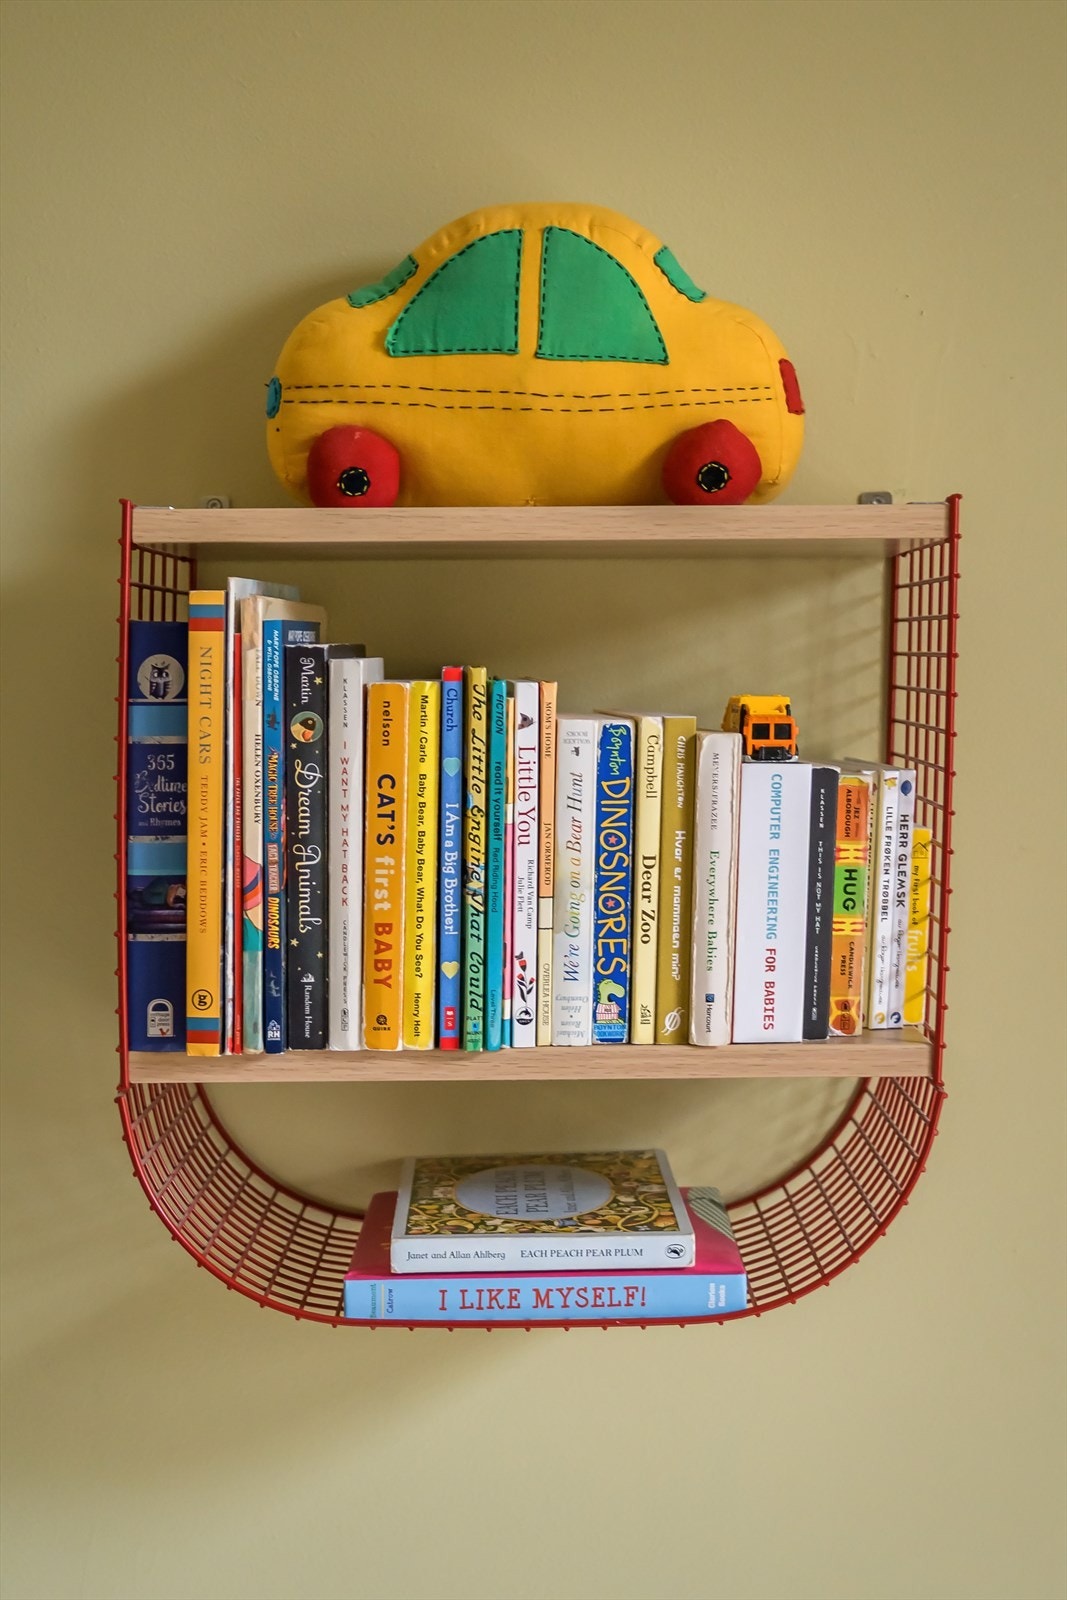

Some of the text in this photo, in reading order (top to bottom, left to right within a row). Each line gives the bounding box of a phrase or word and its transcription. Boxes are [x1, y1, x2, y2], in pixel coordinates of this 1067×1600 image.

[299, 657, 314, 705] Martin
[472, 684, 486, 721] The
[147, 754, 175, 771] 365
[340, 757, 349, 798] WANT
[471, 728, 486, 794] Little
[137, 792, 187, 815] Stories
[198, 646, 213, 934] NIGHT CARS TEDDY JAM ERIC BEDDOWS
[253, 770, 261, 825] OXENBURY
[267, 753, 280, 833] MAGIC TREE HOUSE
[294, 758, 323, 839] Dream
[340, 803, 349, 823] MY
[443, 688, 458, 935] Church I Am a Big Brother!
[516, 746, 537, 847] Little You
[844, 788, 854, 838] ALBOROUGH
[853, 806, 861, 820] JEZ
[340, 828, 349, 859] HAT
[373, 701, 396, 989] nelson CAT'S first BABY
[412, 695, 429, 1037] Martin Carle Baby Bear, Baby Bear, What Do You See? Henry Holt
[468, 805, 486, 882] Engine
[489, 693, 505, 1028] FICTION read it yourself Red Riding Hood Level Three
[541, 702, 552, 1026] MOM'S HOME JAN ORMEROD OVERLEA HOUSE
[596, 725, 630, 976] Boynton DINOSNORES
[640, 734, 659, 945] Campbell Dear Zoo
[670, 735, 686, 981] CHRIS HAUGHTON Hvar er mammaen min?
[880, 806, 894, 922] LILLE FRØKEN TRØBBEL
[896, 814, 910, 908] HERR GLEMSK
[267, 843, 279, 892] FACT TRACKER
[292, 844, 322, 934] Animals
[341, 864, 349, 907] BACK
[563, 773, 586, 982] We're Going on a Bear Hunt
[706, 850, 720, 926] Everywhere
[817, 867, 822, 880] IS
[842, 868, 858, 912] HUG
[467, 888, 485, 942] That
[516, 876, 525, 913] Julie Flett
[523, 859, 534, 930] Richard Van Camp
[763, 774, 783, 1030] COMPUTER ENGINEERING FOR BABIES
[815, 903, 821, 914] MY
[906, 865, 923, 972] my first book of fruits
[267, 897, 280, 950] DINOSAURS
[706, 931, 718, 972] Babies
[847, 941, 855, 989] CANDLEWICK
[304, 984, 313, 1014] Random
[468, 952, 484, 1011] Could
[304, 1015, 313, 1038] House
[705, 1004, 713, 1033] Harcourt
[495, 1195, 518, 1216] EACH
[524, 1192, 549, 1213] PEAR
[407, 1248, 643, 1261] Janet and Allan Ahlberg EACH PEACH PEAR PLUM
[386, 1288, 394, 1314] Catrow
[439, 1286, 647, 1311] I LIKE MYSELF!
